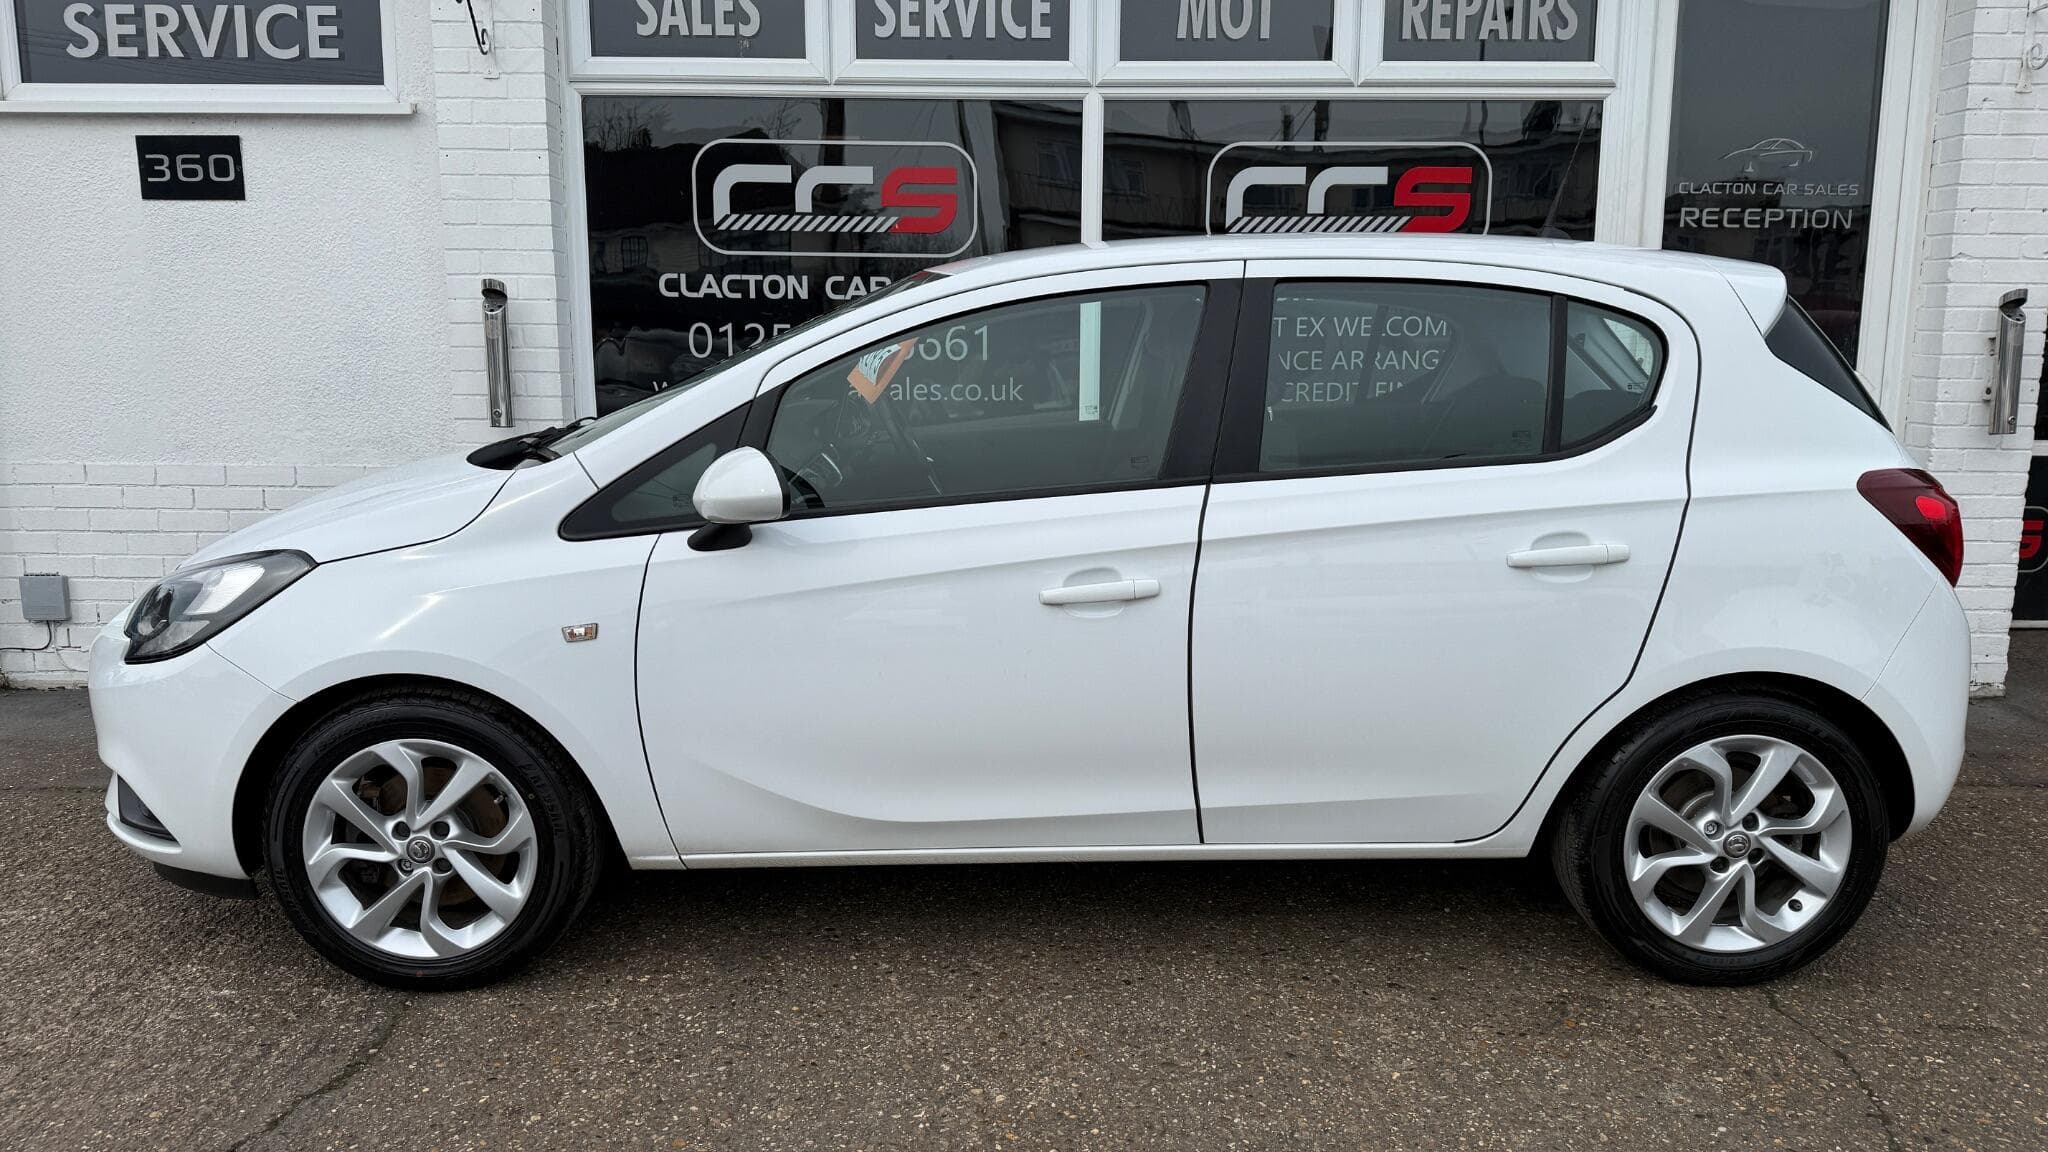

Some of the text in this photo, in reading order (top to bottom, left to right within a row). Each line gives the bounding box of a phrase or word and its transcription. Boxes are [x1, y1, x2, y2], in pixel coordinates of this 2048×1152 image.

[62, 2, 340, 60] SERVICE
[635, 0, 761, 37] SALES
[874, 0, 1052, 40] SERVICE
[1401, 0, 1578, 41] REPAIRS
[144, 153, 236, 182] 360
[1679, 182, 1860, 196] CLACTON CAR SALES
[1679, 207, 1853, 230] RECEPTION
[658, 272, 809, 300] CLACTON
[1296, 317, 1326, 337] EX
